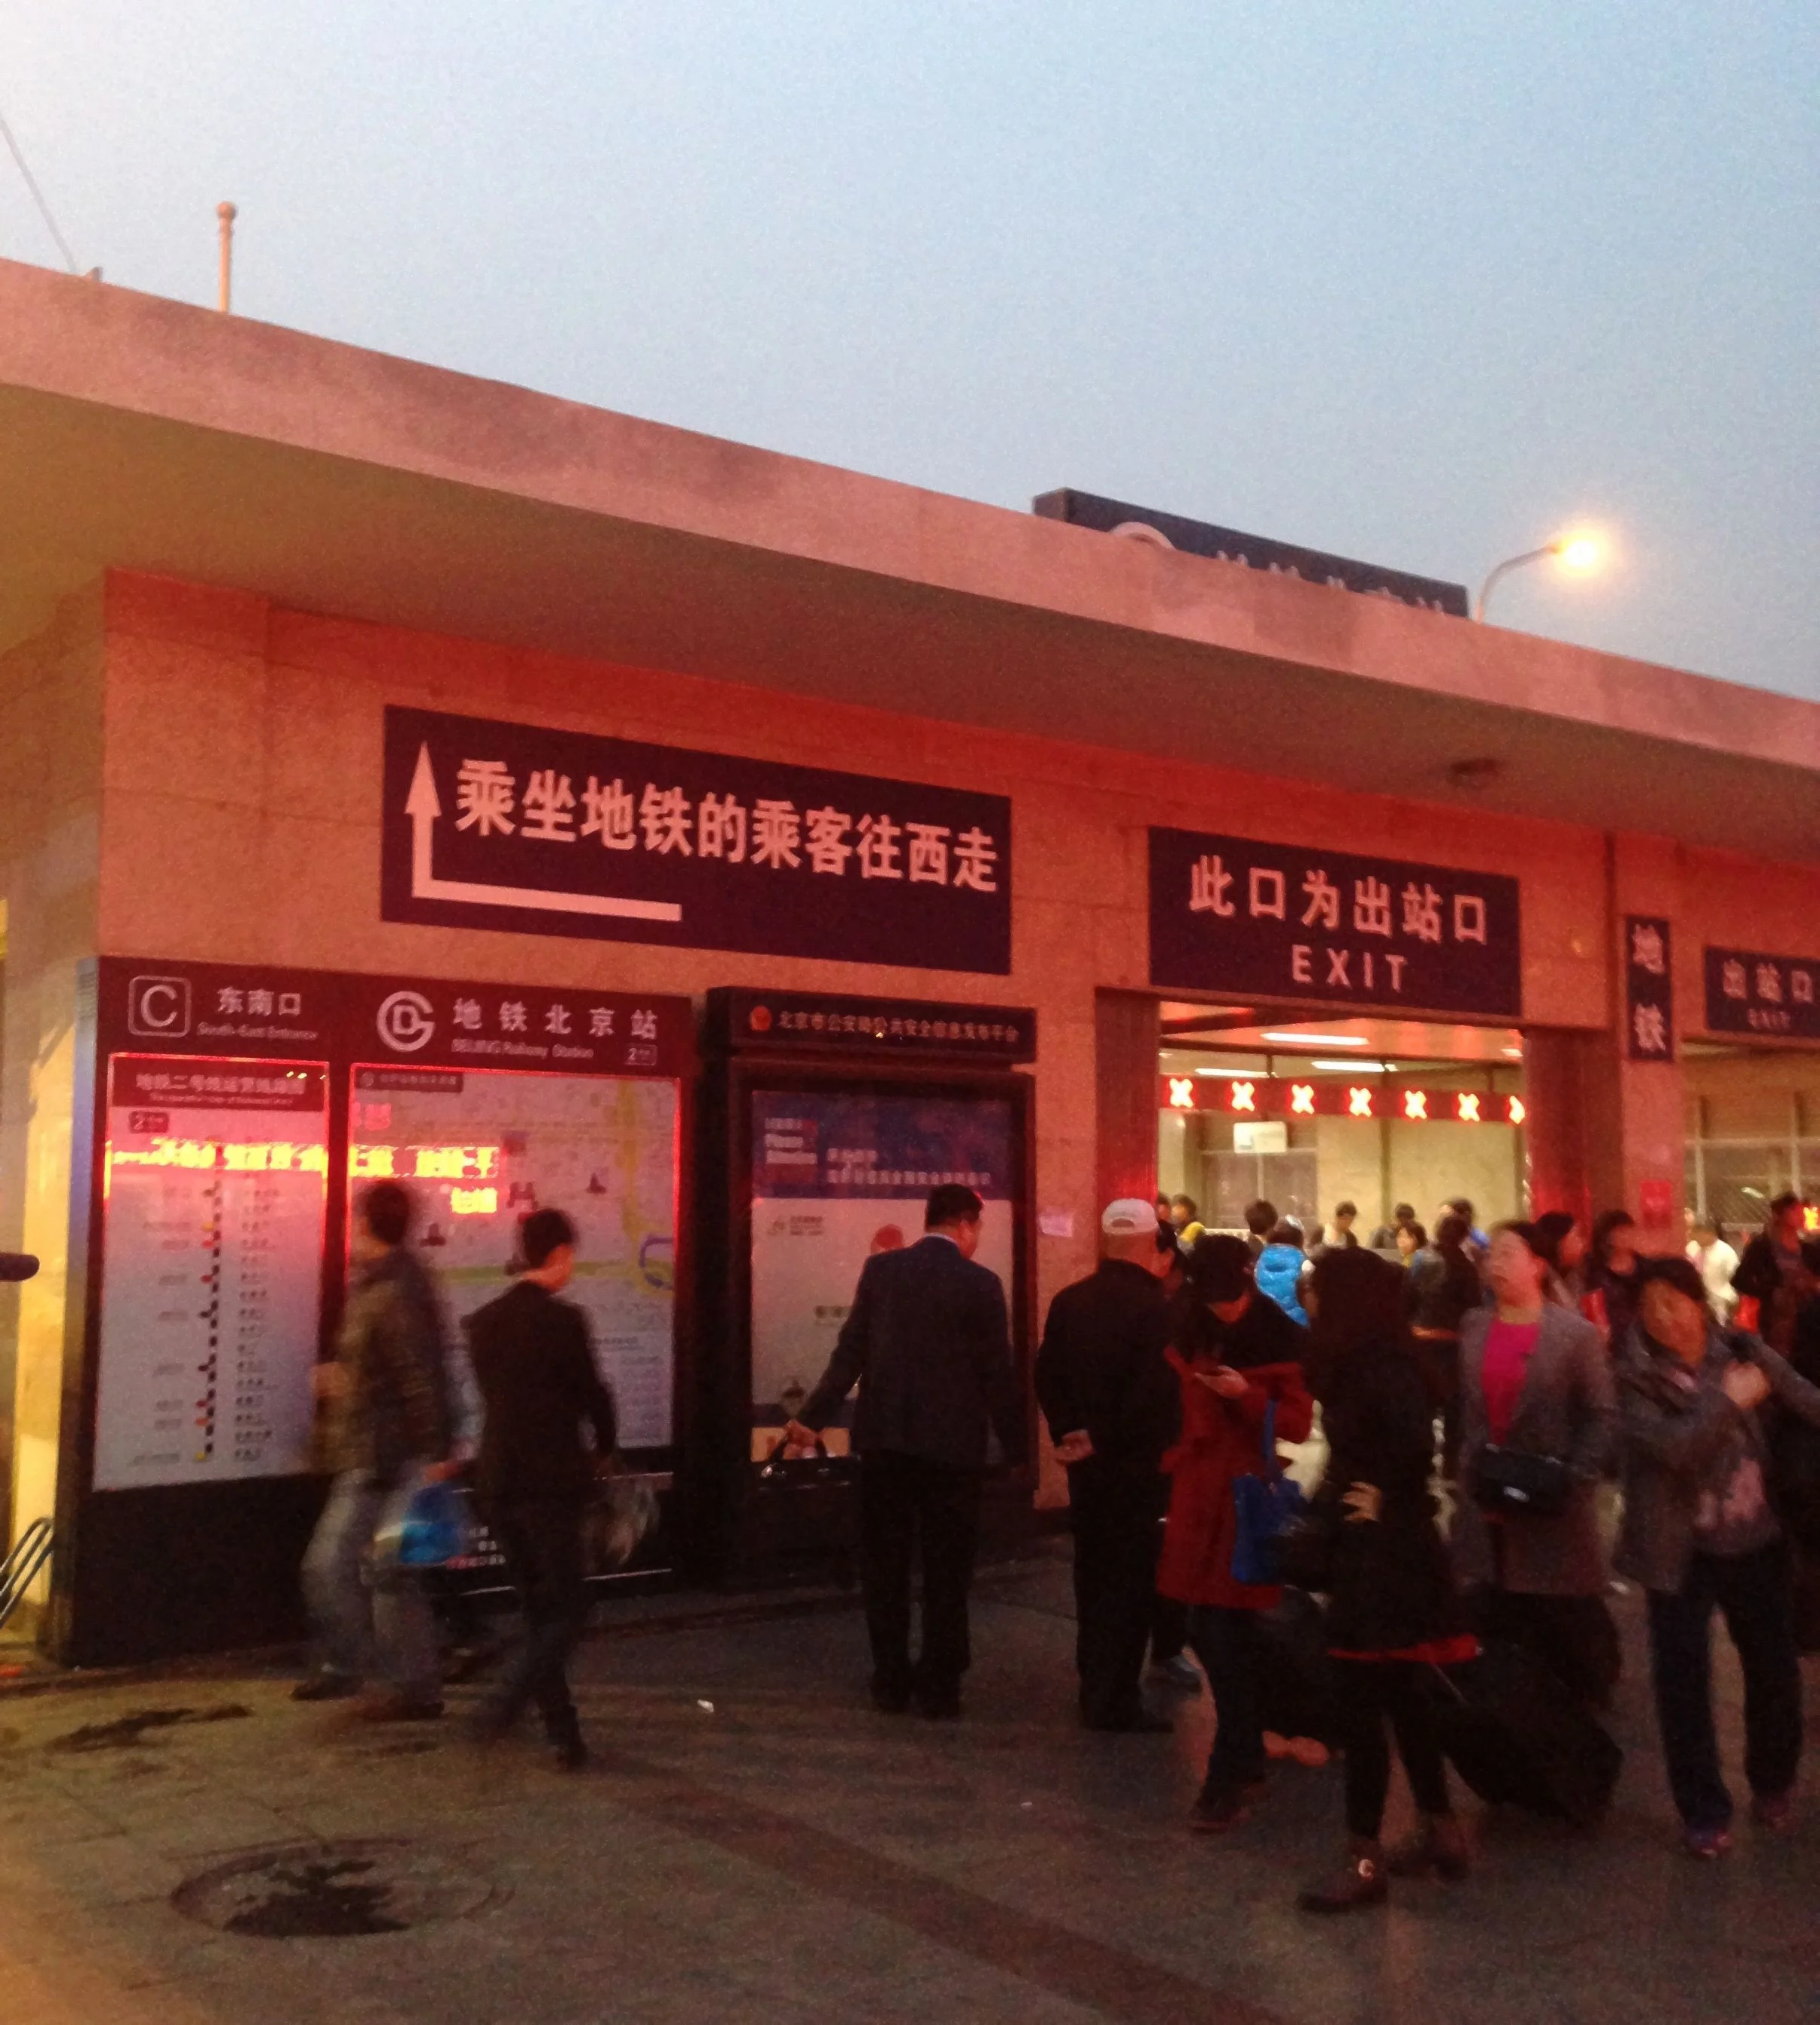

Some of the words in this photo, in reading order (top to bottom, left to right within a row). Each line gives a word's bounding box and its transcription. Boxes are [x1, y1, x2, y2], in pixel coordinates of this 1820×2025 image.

[454, 758, 999, 892] 乘坐地铁的乘客往西走
[1188, 854, 1487, 945] 此口为出站口
[1290, 944, 1408, 994] EXIT
[140, 983, 178, 1028] C
[215, 986, 301, 1017] 东南口
[453, 997, 657, 1040] 地铁北京站
